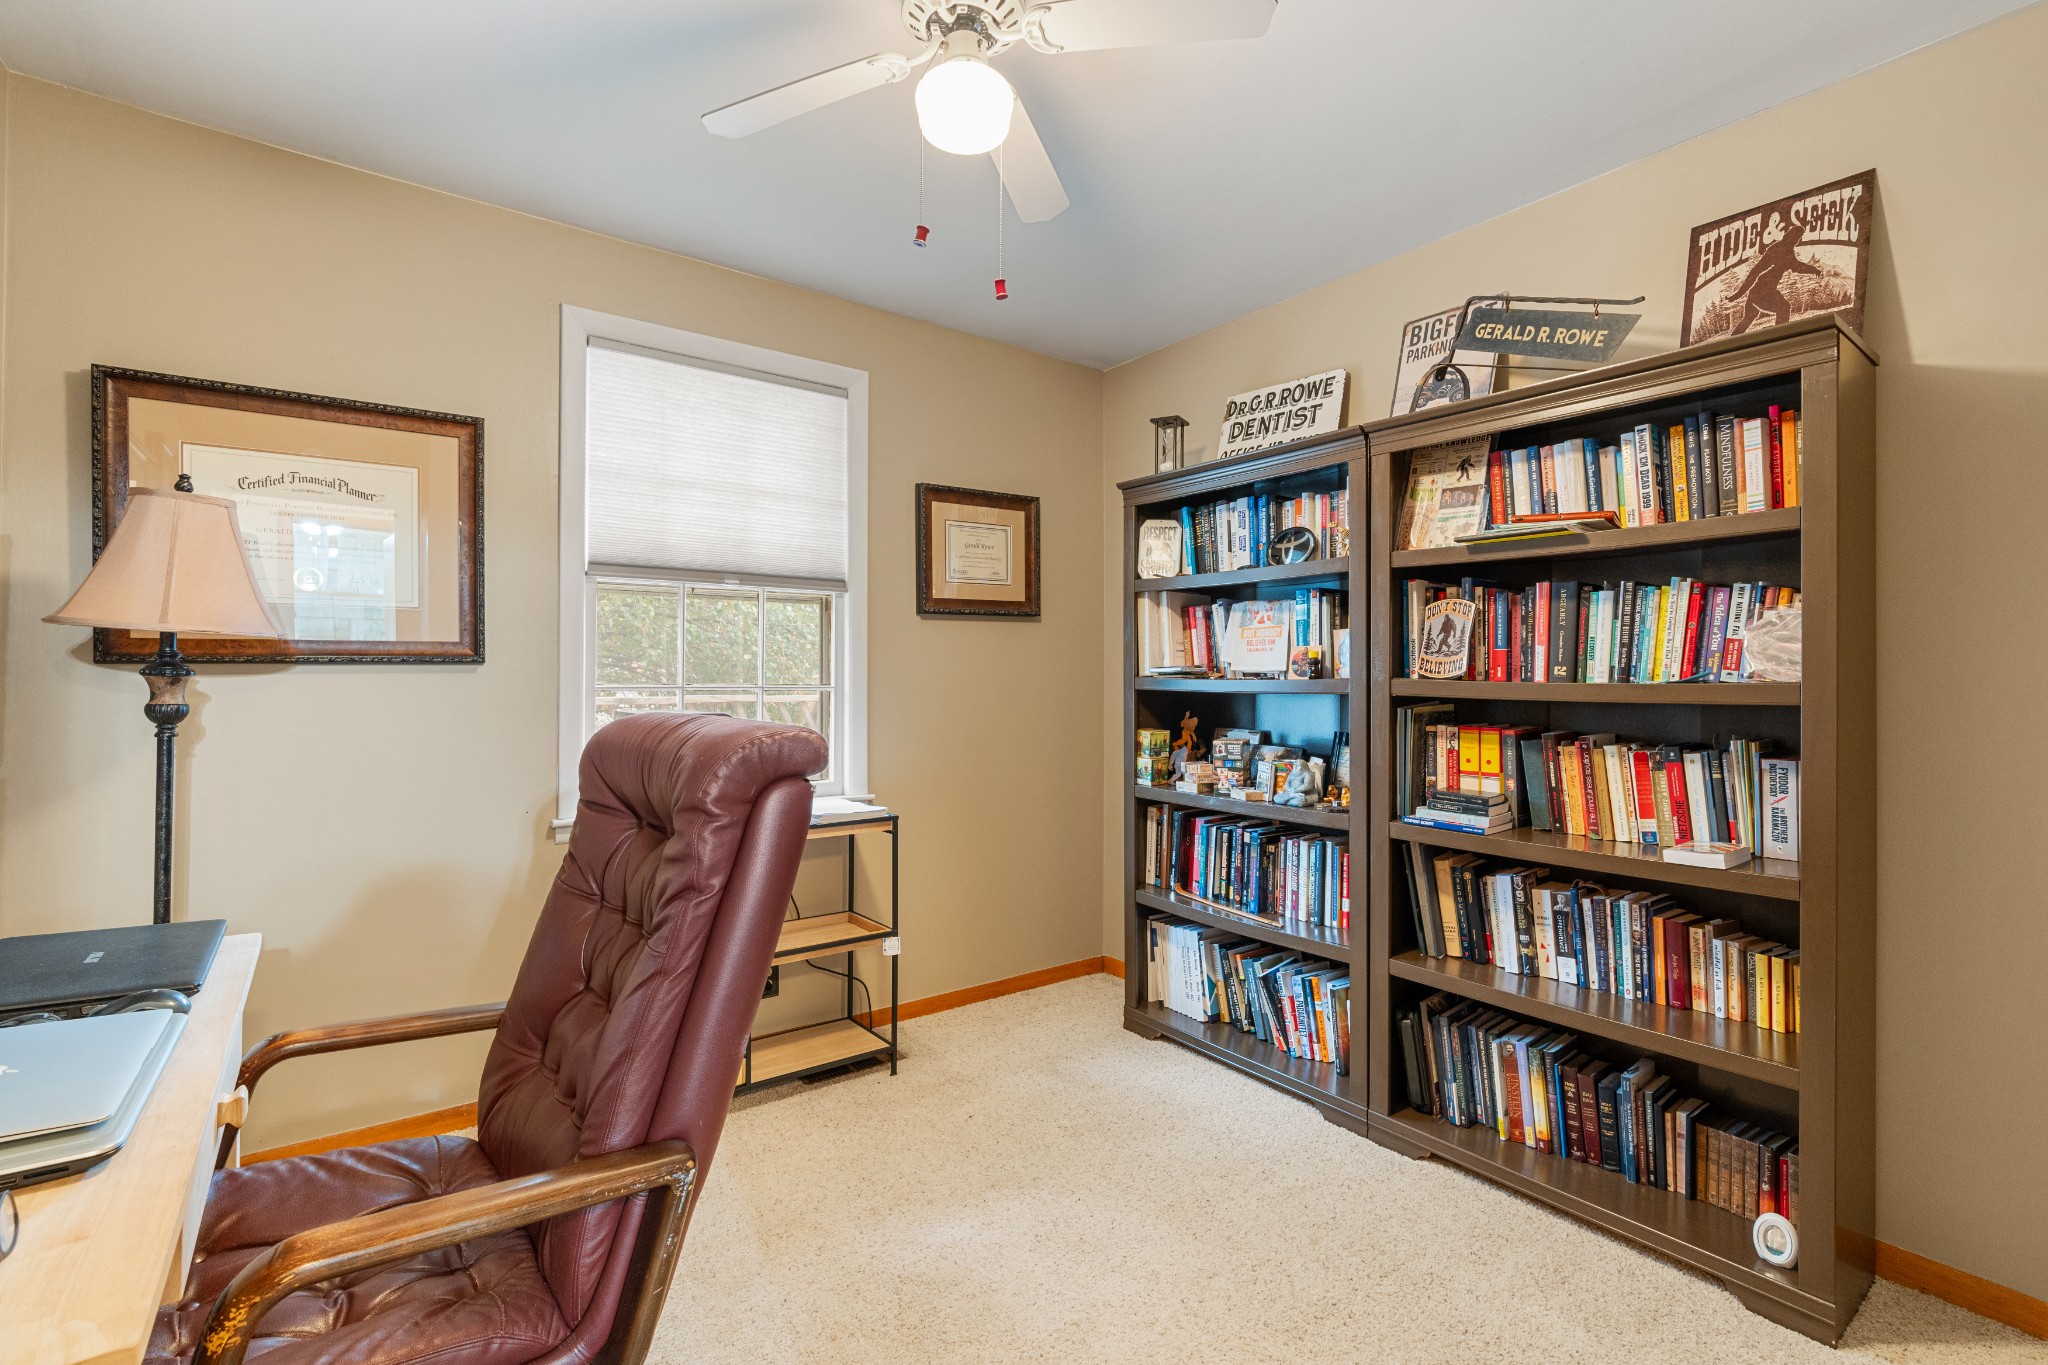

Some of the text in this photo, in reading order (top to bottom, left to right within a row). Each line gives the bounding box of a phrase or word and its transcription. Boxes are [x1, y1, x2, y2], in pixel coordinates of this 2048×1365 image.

[1695, 184, 1863, 289] HIDE & SEEK
[1475, 322, 1608, 347] GERALD R. ROWE
[1227, 403, 1323, 444] DENTIST
[1446, 434, 1491, 448] KNOWLEDGE
[1637, 427, 1647, 454] KNOCK
[1719, 424, 1733, 490] MINDFULNESS
[1773, 450, 1781, 482] AUDIBLE
[238, 472, 378, 501] Certified Financial Planner
[1588, 477, 1597, 504] Grieving
[1640, 469, 1650, 490] DEAD
[1642, 492, 1652, 508] 1999
[1144, 526, 1178, 541] RESPECT
[1716, 592, 1724, 604] The
[1737, 586, 1746, 599] WHY
[1426, 600, 1473, 620] DON'T STOP
[1714, 604, 1725, 626] Idea
[1734, 601, 1743, 624] NATIONS
[1246, 639, 1267, 647] BELIEVES
[1711, 633, 1721, 650] You
[1732, 626, 1740, 637] FAIL
[1588, 636, 1596, 661] RECOVERY
[1419, 656, 1464, 675] BELIEVING
[1582, 751, 1591, 775] solution
[1769, 763, 1778, 797] DOSTOEVSKY
[1778, 767, 1789, 795] FYODOR
[1585, 776, 1594, 813] mindfulness
[1676, 800, 1688, 840] NIETZSCHE
[1771, 807, 1780, 842] KARAMAZOV
[1780, 815, 1789, 843] BROTHERS
[1557, 914, 1565, 953] OPPENHEIMER
[1296, 1000, 1307, 1037] PARACHUTE?
[1511, 1073, 1522, 1118] EINSTEIN
